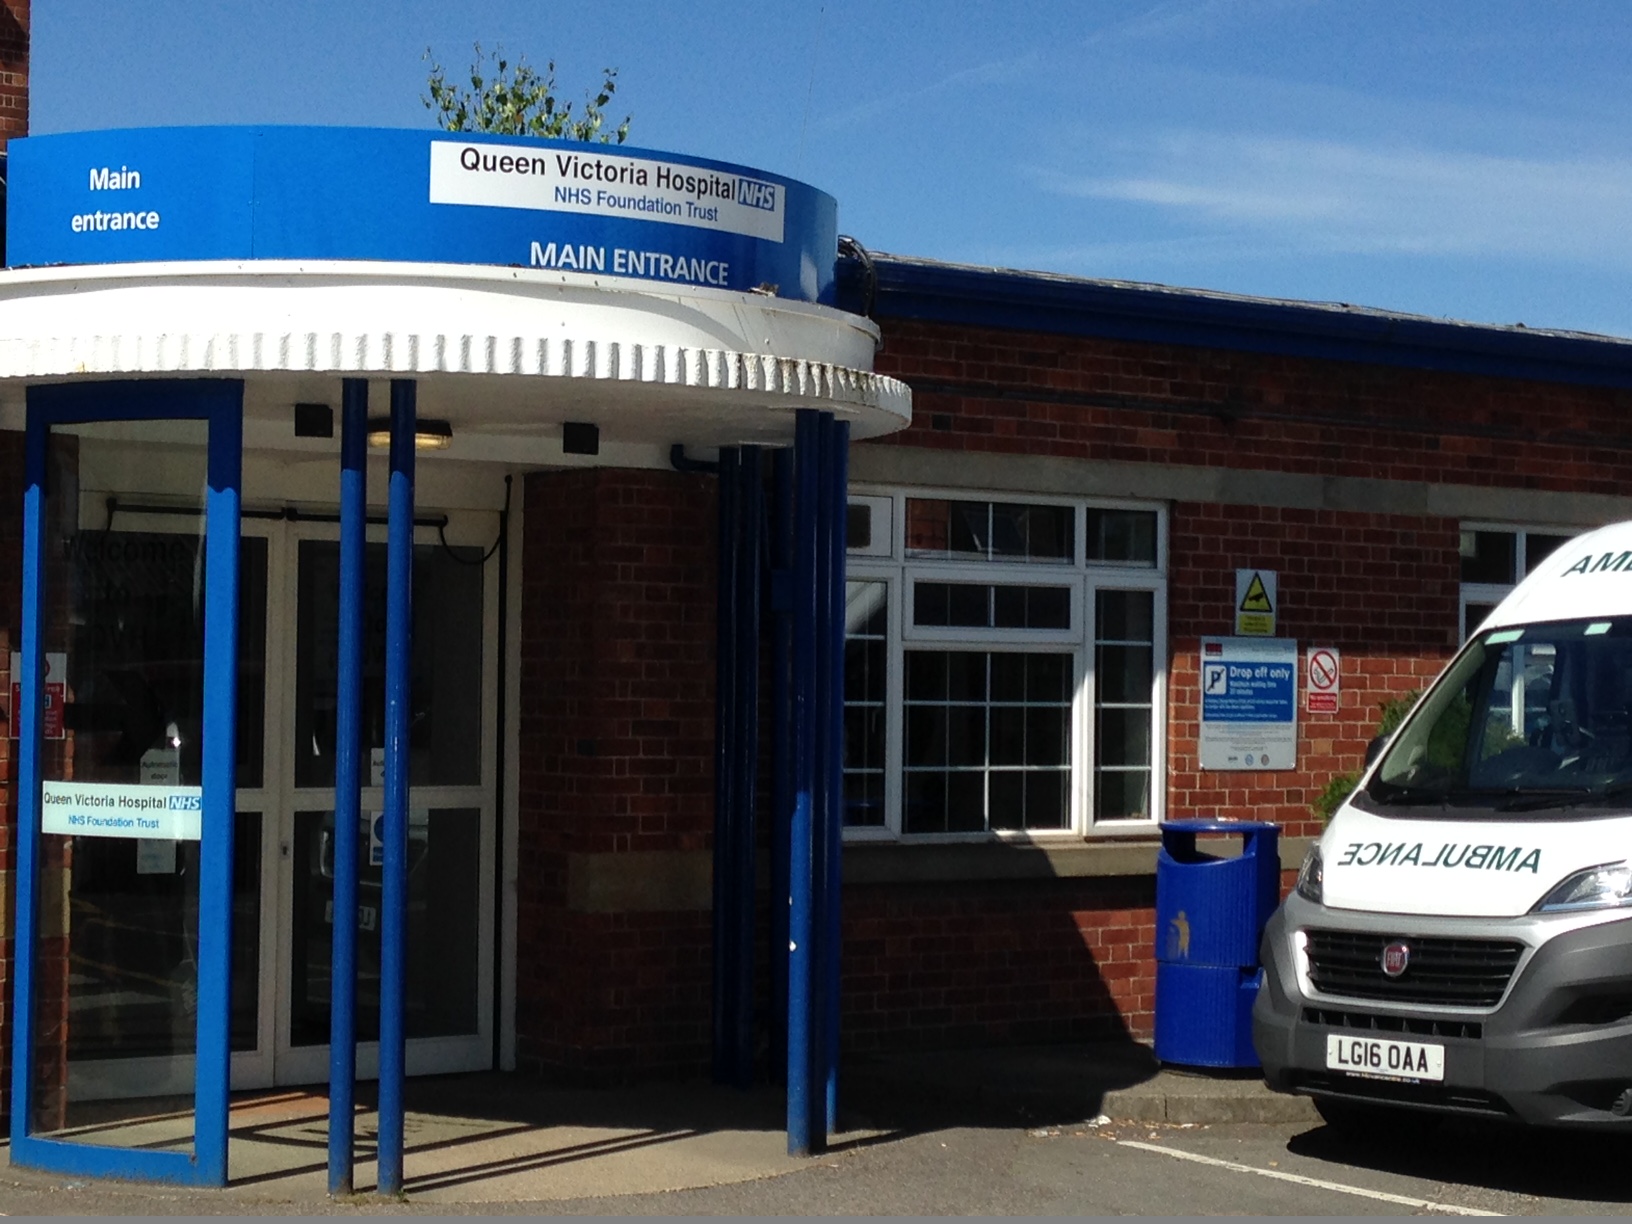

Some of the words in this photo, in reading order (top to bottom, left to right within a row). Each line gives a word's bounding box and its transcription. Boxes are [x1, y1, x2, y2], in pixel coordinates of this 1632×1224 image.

[89, 165, 141, 191] Main
[460, 147, 545, 176] Queen
[556, 154, 648, 187] Victoria
[656, 165, 736, 200] Hospital
[738, 179, 775, 211] NHS
[554, 186, 592, 206] NHS
[596, 189, 682, 216] Foundation
[685, 201, 719, 222] Trust
[71, 209, 160, 233] entrance
[530, 241, 605, 271] MAIN
[613, 248, 730, 287] ENTRANCE
[1229, 665, 1252, 680] Drop
[1254, 666, 1268, 679] off
[1270, 668, 1291, 681] only
[44, 791, 72, 805] Queen
[75, 793, 115, 807] Victoria
[118, 795, 167, 811] Hospital
[169, 796, 202, 811] NHS
[68, 815, 85, 826] NHS
[87, 816, 134, 828] Foundation
[136, 817, 160, 829] Trust
[1338, 1039, 1381, 1068] LG16
[1388, 1044, 1429, 1073] OAA
